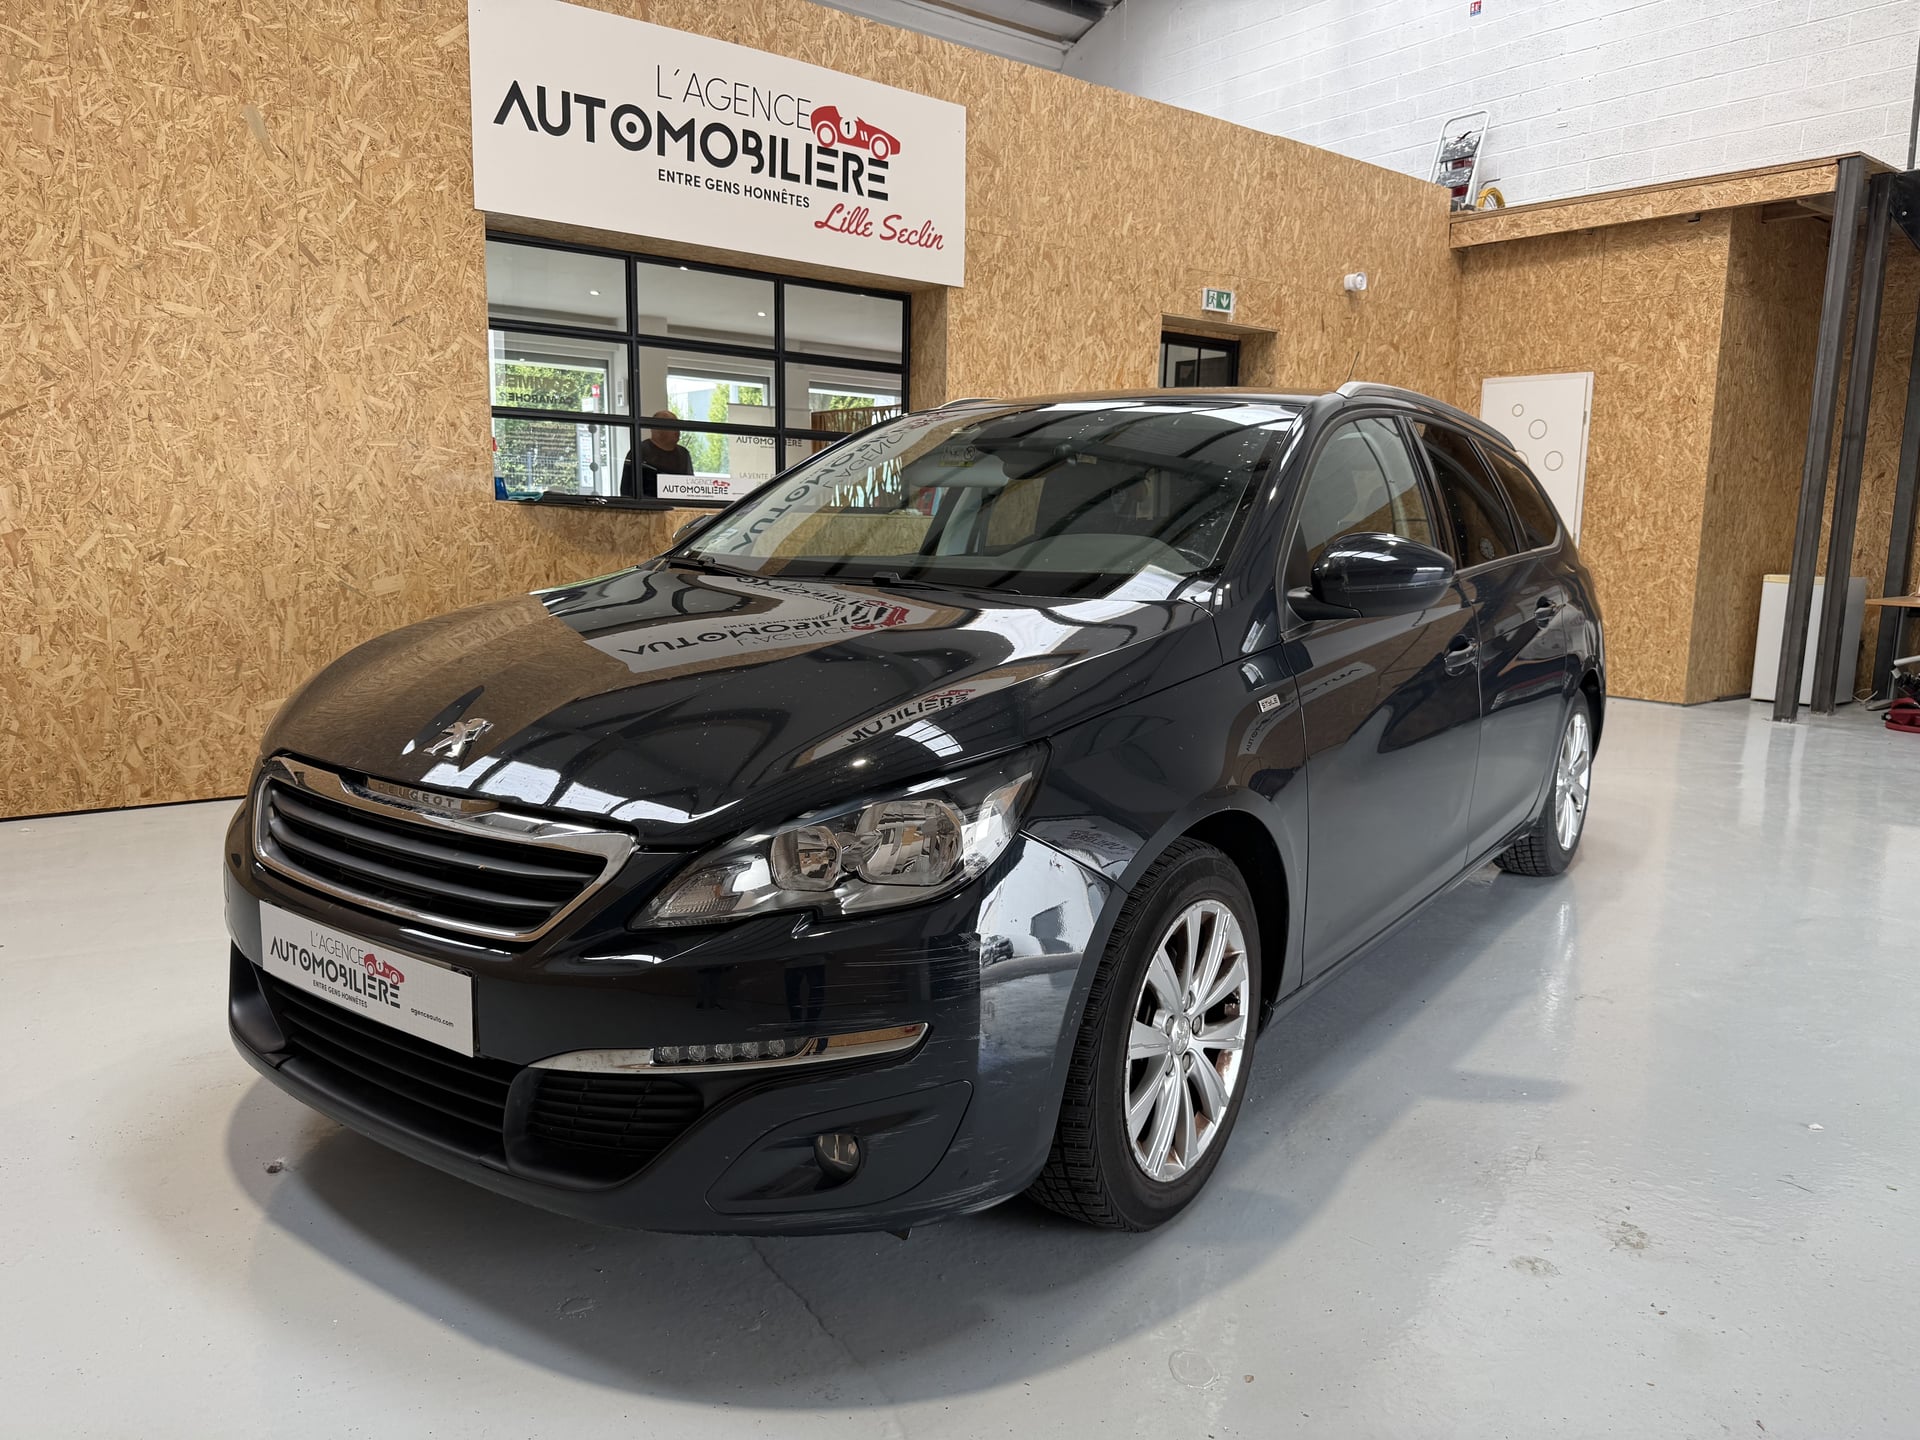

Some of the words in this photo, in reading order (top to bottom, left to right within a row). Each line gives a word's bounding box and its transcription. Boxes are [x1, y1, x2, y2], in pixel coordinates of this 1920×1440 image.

[656, 64, 811, 131] L'AGENCE
[493, 79, 889, 202] AUTOMOBILIERE
[844, 121, 850, 135] 1
[657, 168, 701, 188] ENTRE
[705, 177, 740, 195] GENS
[744, 185, 810, 208] HONNÊTES
[814, 203, 873, 237] Lille
[879, 214, 944, 251] Seclin
[662, 484, 729, 495] AUTOMOBILIERE
[377, 784, 454, 807] PEUGEOT
[310, 930, 365, 967] L'AGENCE
[270, 935, 400, 1009] AUTOMOBILIERE
[313, 979, 328, 992] ENTRE
[328, 986, 341, 997] GENS
[341, 991, 368, 1008] HONNÊTES
[410, 1007, 454, 1028] agenceauto.com
